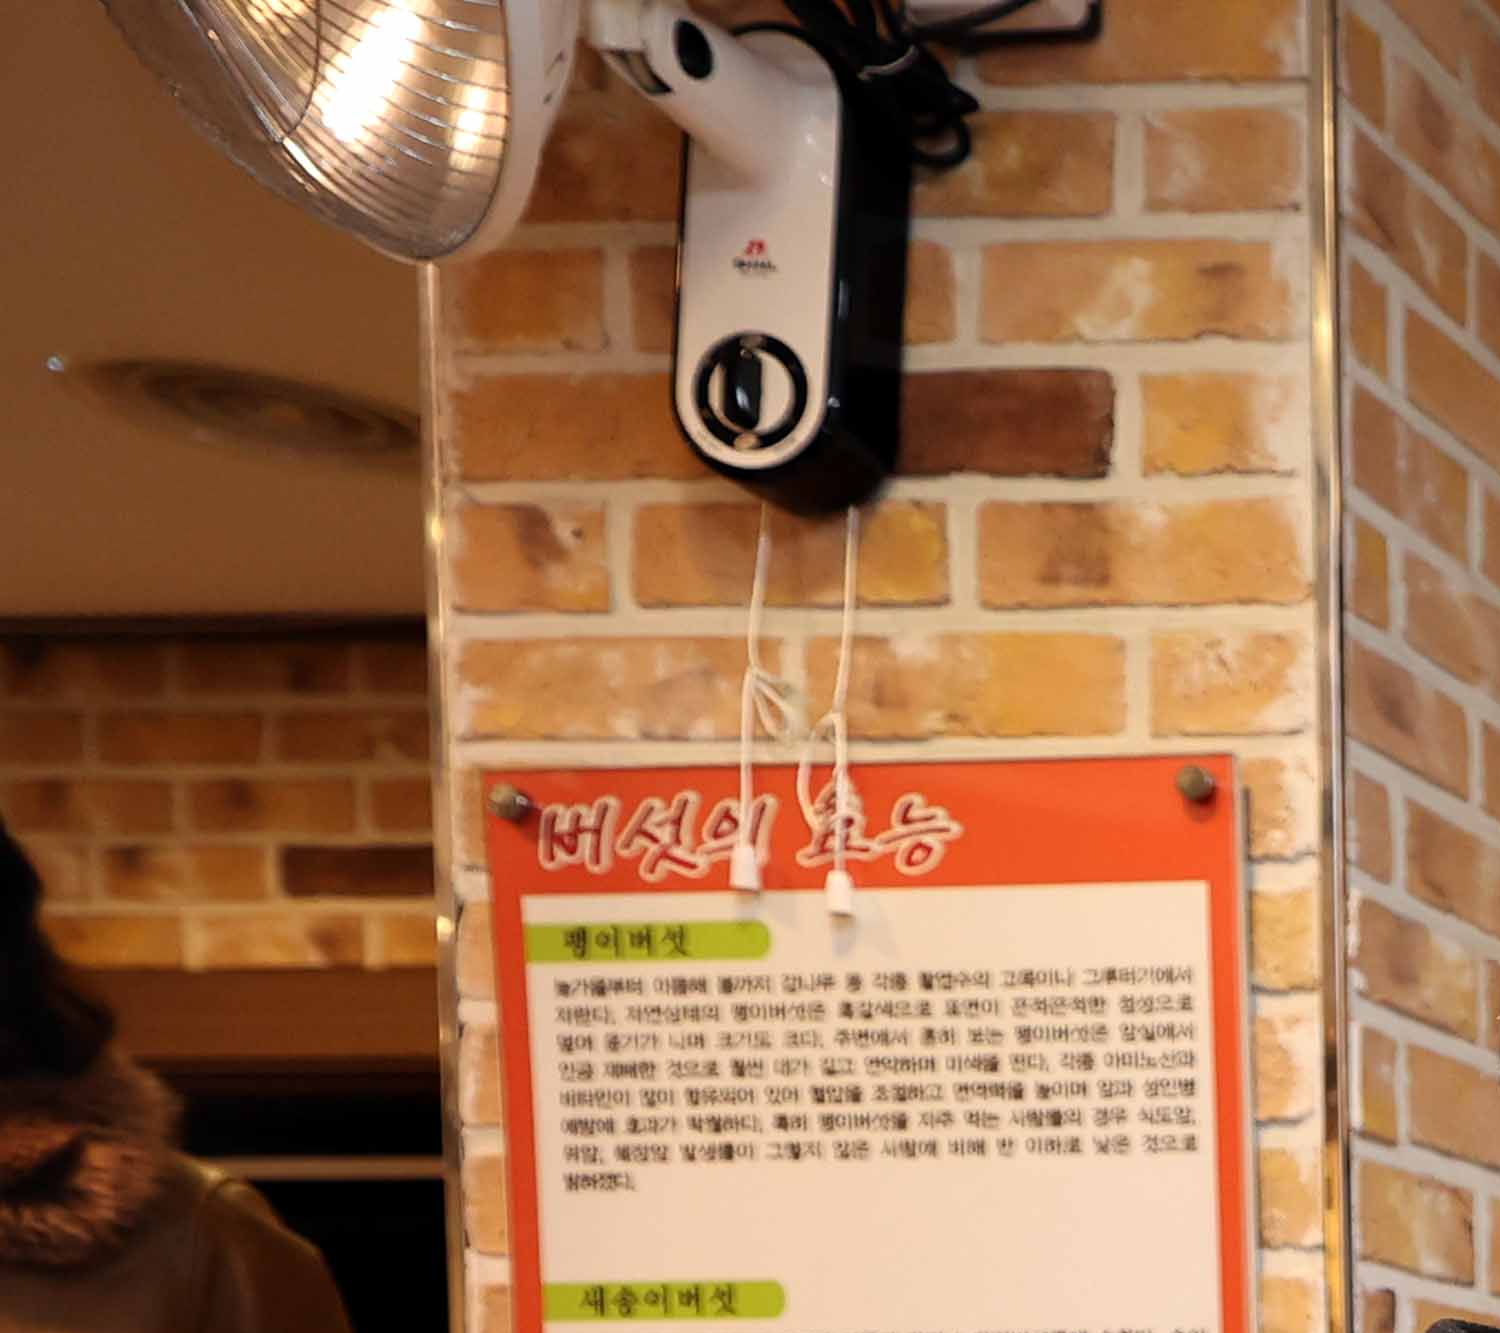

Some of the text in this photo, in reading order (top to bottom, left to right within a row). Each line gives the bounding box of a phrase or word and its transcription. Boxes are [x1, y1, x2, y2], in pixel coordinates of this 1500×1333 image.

[538, 791, 778, 883] 버섯의
[563, 922, 691, 958] 팽이버섯
[580, 1283, 737, 1319] 새송이버섯
